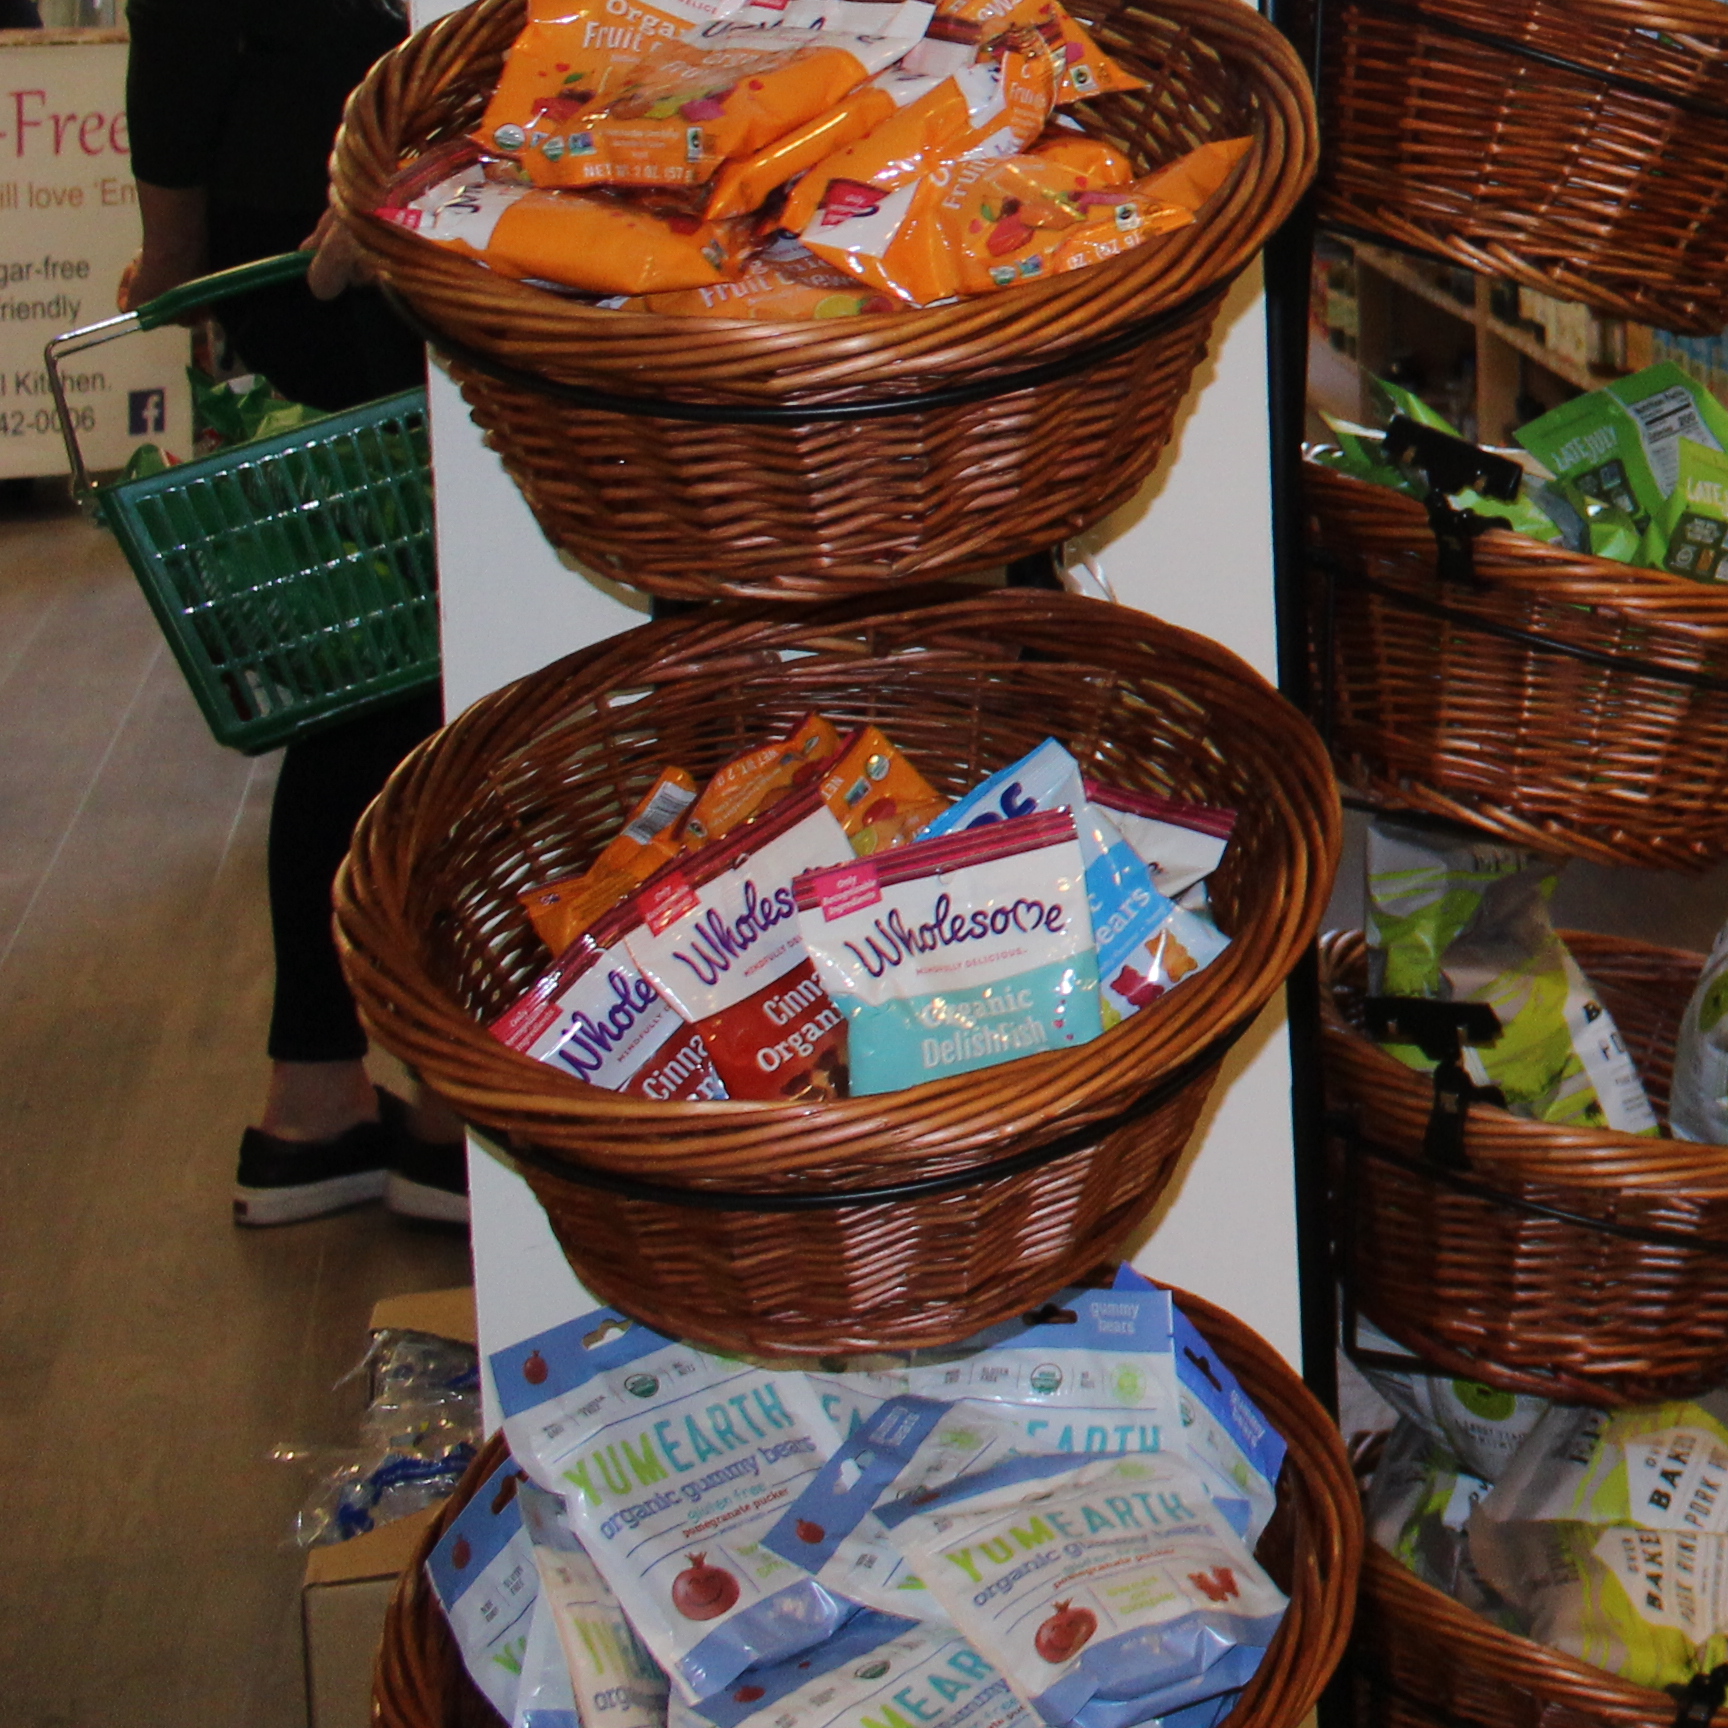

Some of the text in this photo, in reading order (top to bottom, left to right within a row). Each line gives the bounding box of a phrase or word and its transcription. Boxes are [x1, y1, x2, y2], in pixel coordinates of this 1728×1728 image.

[581, 19, 642, 52] Fruit
[28, 180, 85, 209] love
[699, 271, 775, 308] Fruit
[15, 370, 112, 396] Kithen.
[1686, 475, 1723, 504] LATE
[821, 775, 845, 801] NET
[672, 879, 797, 986] Wholes
[843, 892, 1067, 978] Wholesome
[1094, 885, 1151, 951] ears
[558, 969, 661, 1084] Whole
[599, 1486, 684, 1540] organic
[757, 1434, 818, 1466] bears
[752, 1485, 789, 1512] pucker
[972, 1550, 1062, 1609] organic
